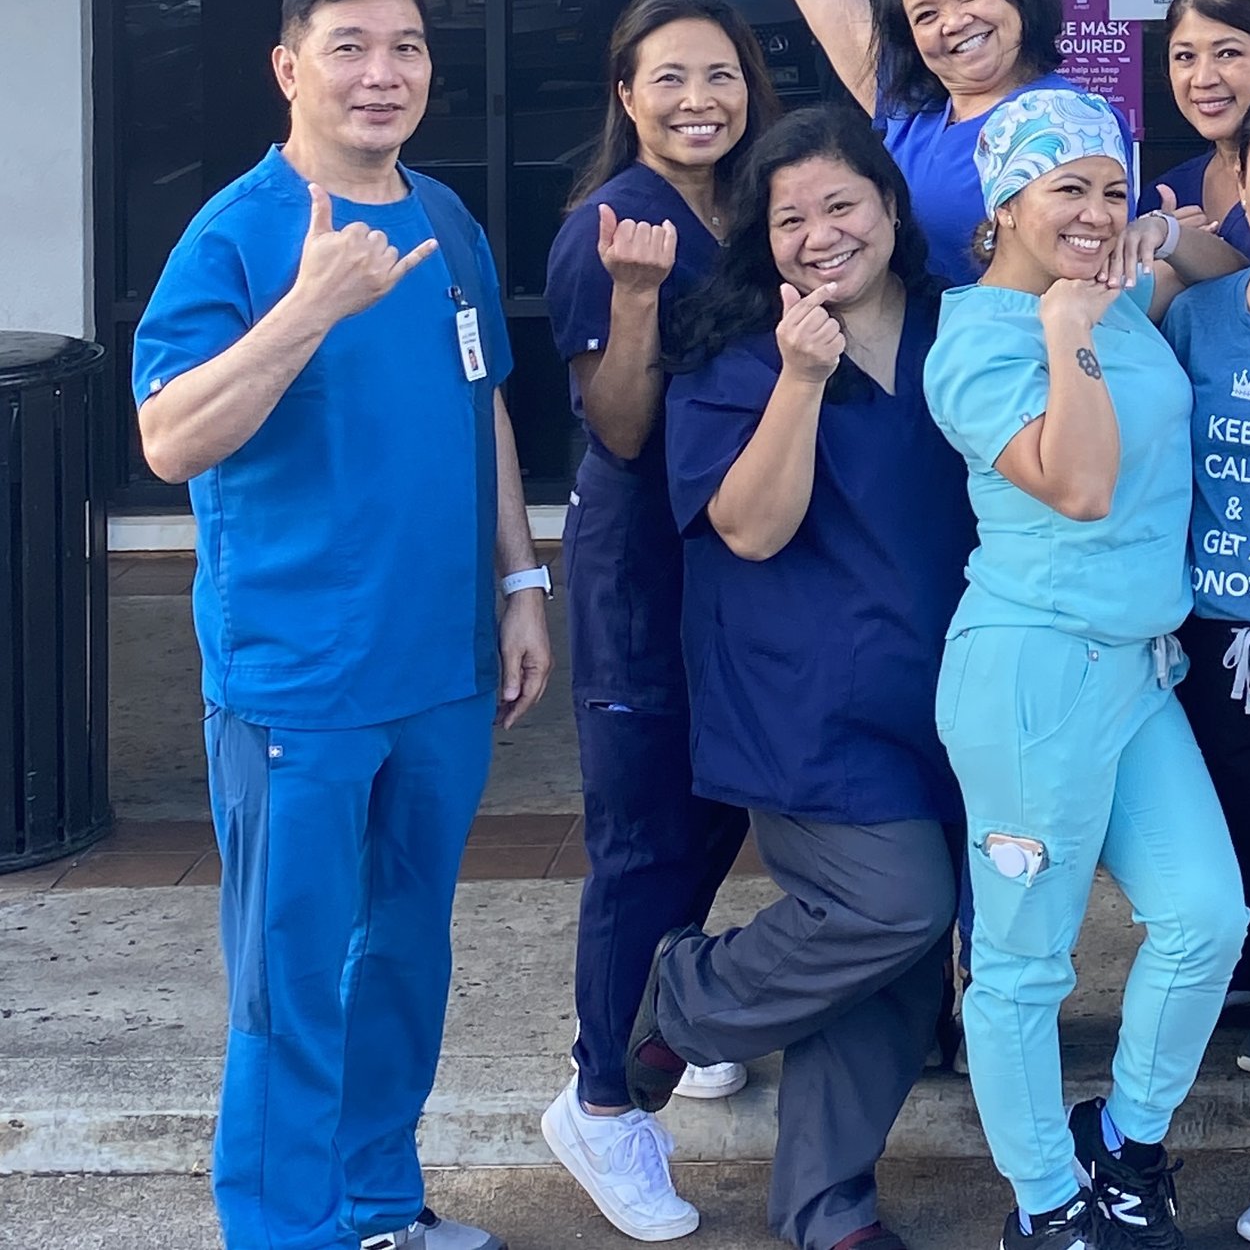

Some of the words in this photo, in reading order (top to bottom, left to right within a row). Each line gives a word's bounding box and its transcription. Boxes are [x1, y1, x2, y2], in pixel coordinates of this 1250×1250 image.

[1061, 21, 1077, 36] E
[1081, 21, 1130, 36] MASK
[1055, 38, 1126, 54] QUIRED
[1225, 496, 1242, 521] &
[1203, 529, 1247, 559] GET
